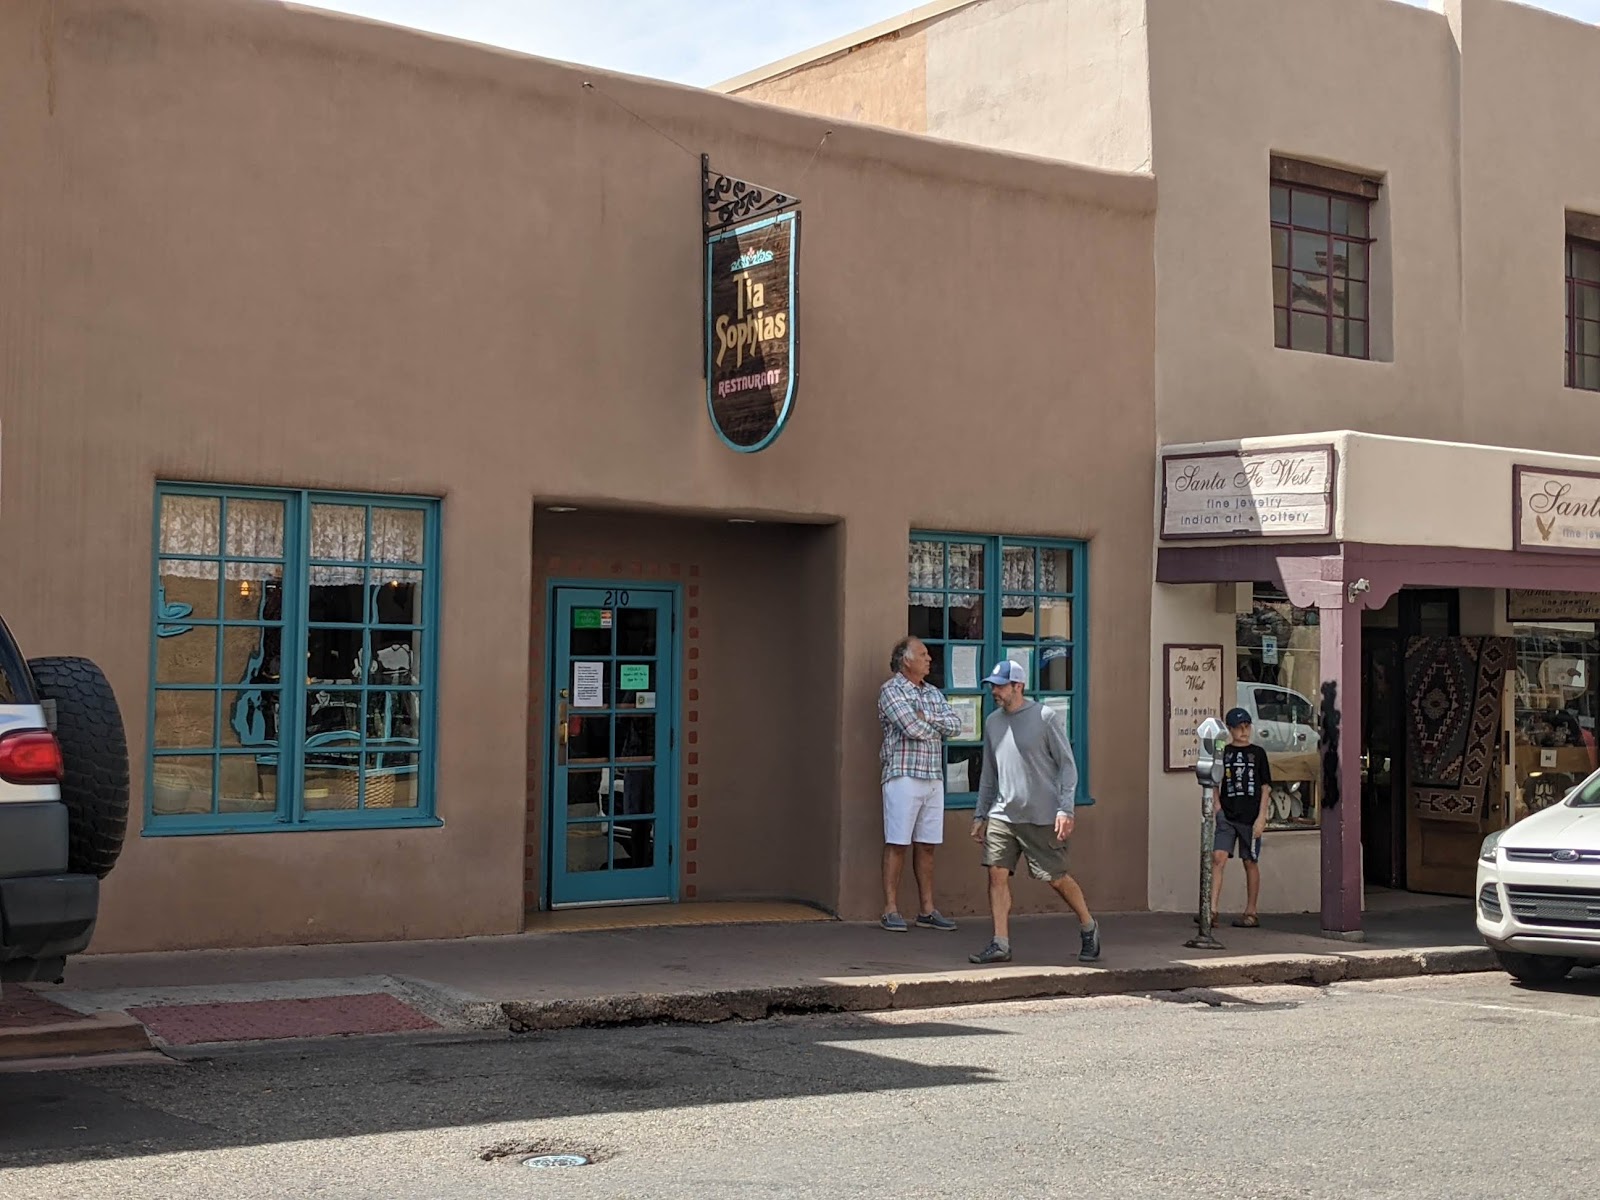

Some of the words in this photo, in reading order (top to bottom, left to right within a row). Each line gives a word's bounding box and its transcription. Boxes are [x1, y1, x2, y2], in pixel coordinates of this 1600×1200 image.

[733, 271, 764, 319] Tia
[715, 310, 786, 368] Sophias
[718, 369, 780, 398] RESTAURANT
[1175, 465, 1226, 492] Santa
[1233, 461, 1265, 488] Fe
[1270, 458, 1315, 487] West
[1206, 499, 1230, 508] fine
[1235, 497, 1282, 510] jewelry
[1529, 480, 1600, 518] Sant
[1181, 513, 1219, 525] indian
[1225, 512, 1242, 523] art
[1261, 511, 1309, 523] pottery
[1562, 527, 1581, 538] fine
[603, 590, 630, 606] 210
[1559, 599, 1590, 607] jewelry
[1173, 655, 1199, 672] Santa
[1202, 656, 1217, 672] Fe
[1185, 675, 1205, 691] West
[1174, 707, 1188, 716] fine
[1190, 707, 1217, 717] jewelry
[1177, 727, 1198, 736] india
